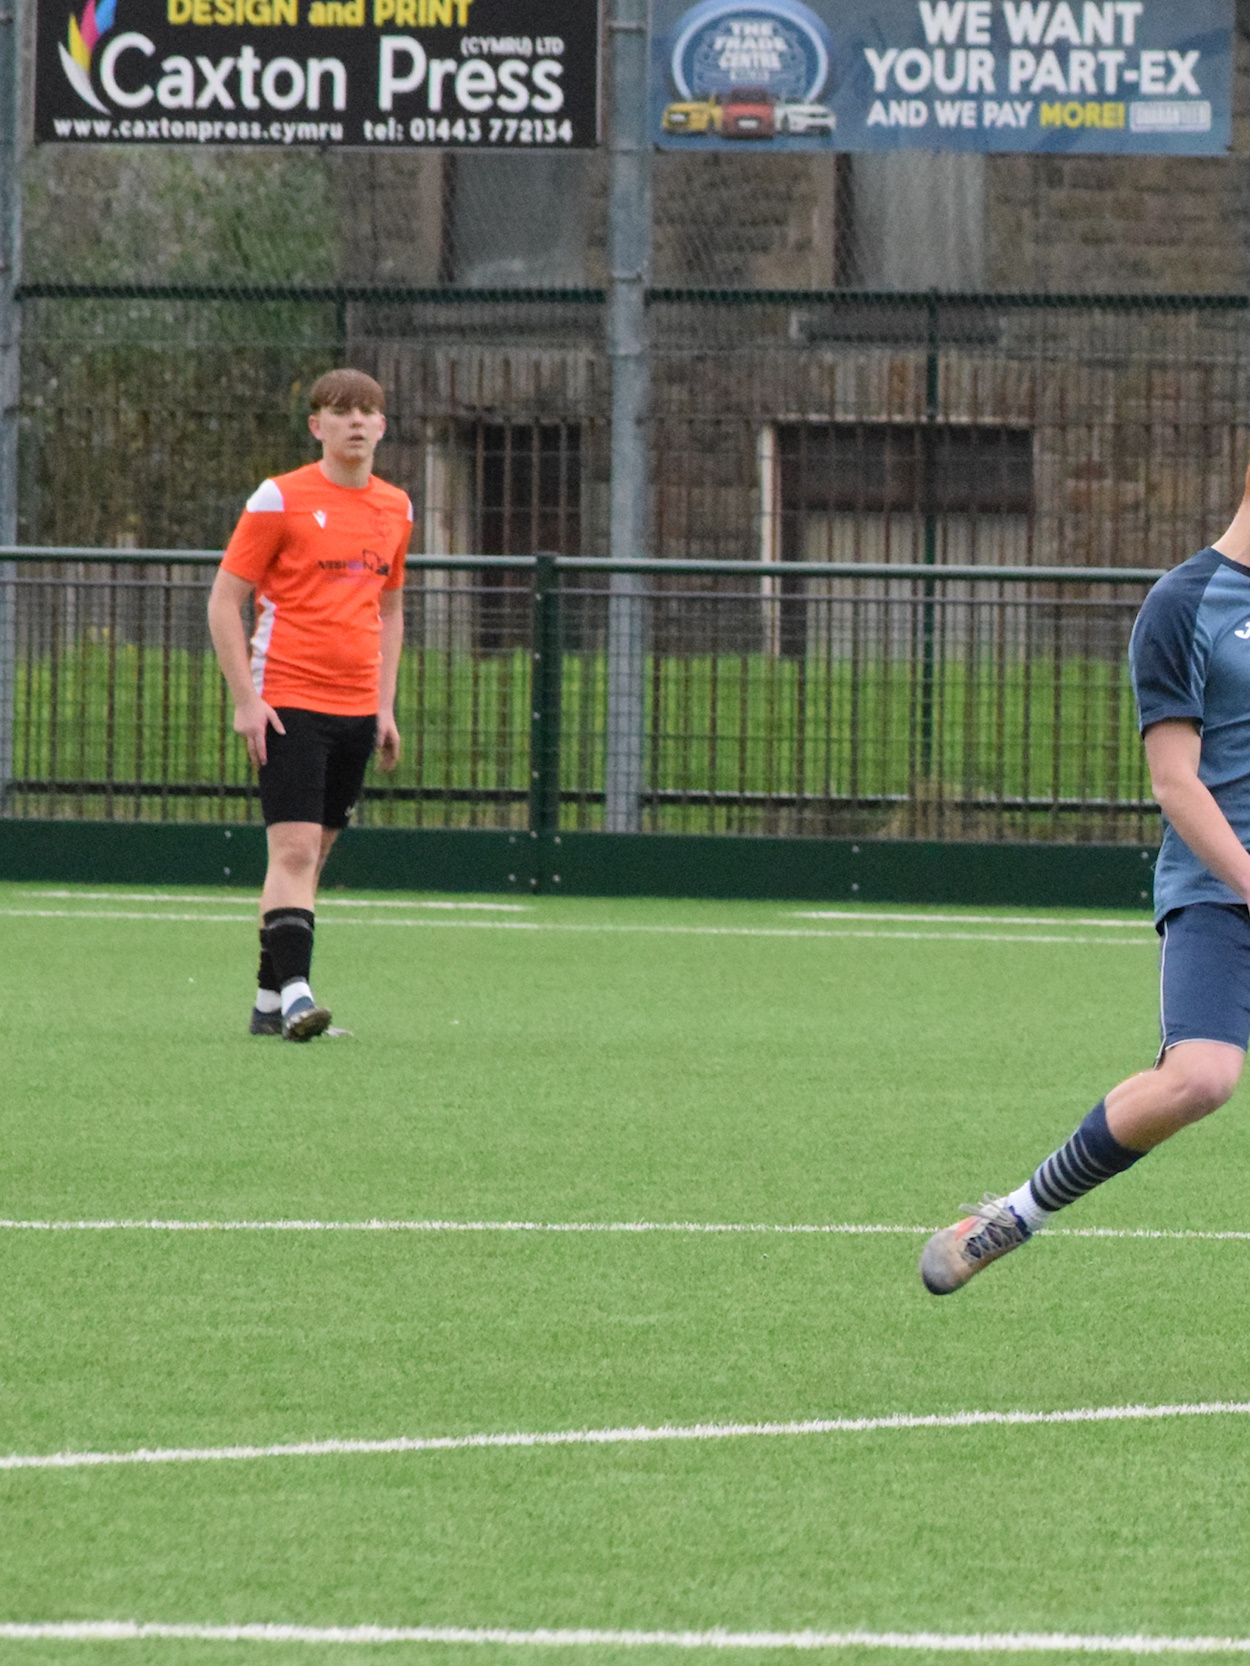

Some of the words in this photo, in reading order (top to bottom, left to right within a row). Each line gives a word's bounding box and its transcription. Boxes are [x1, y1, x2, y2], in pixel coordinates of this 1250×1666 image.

[168, 0, 297, 26] DESIGN
[308, 0, 365, 27] and
[374, 0, 474, 28] PRINT
[920, 1, 992, 46] WE
[1004, 1, 1144, 47] WANT
[729, 22, 775, 36] THE
[536, 36, 565, 55] LTD
[100, 32, 347, 110] Caxton
[378, 35, 565, 112] Press
[864, 48, 996, 94] YOUR
[1009, 48, 1201, 96] PART-EX
[867, 101, 929, 127] AND
[934, 101, 978, 128] WE
[983, 101, 1033, 128] PAY
[1040, 102, 1125, 129] MORE!
[53, 117, 344, 142] www.caxtonpress.cymru
[363, 118, 404, 141] tel:
[410, 118, 482, 143] 01443
[488, 119, 573, 143] 772134
